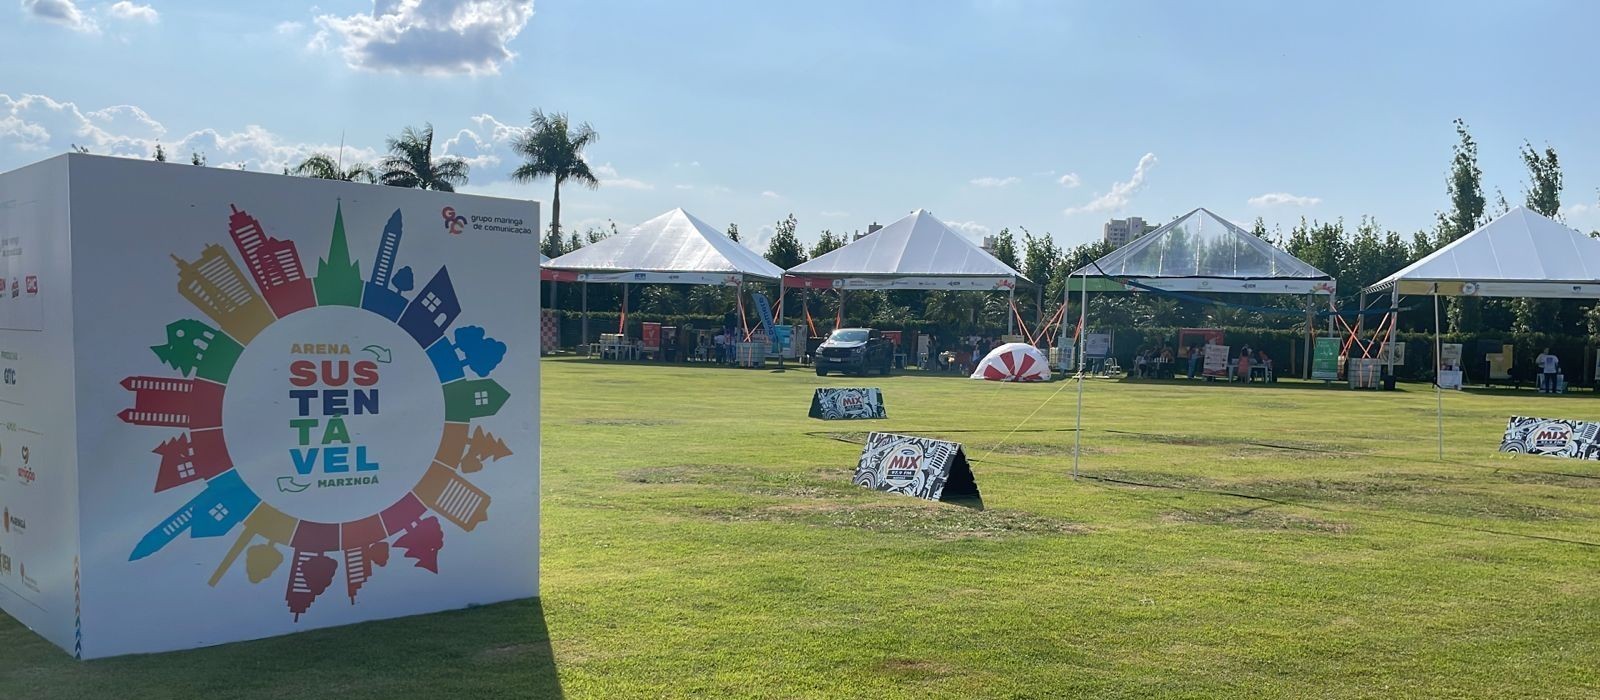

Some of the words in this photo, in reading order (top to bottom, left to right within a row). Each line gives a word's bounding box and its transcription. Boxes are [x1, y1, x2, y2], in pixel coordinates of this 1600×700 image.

[471, 215, 493, 223] grupo
[473, 223, 483, 231] de
[290, 343, 352, 355] ARENA
[289, 360, 379, 387] SUS
[289, 389, 379, 416] TEN
[843, 396, 862, 406] MIX
[289, 412, 352, 445] TÁ
[1536, 430, 1570, 440] MIX
[289, 446, 379, 475] VEL
[888, 455, 922, 469] MIX
[317, 474, 380, 488] MARINGÁ
